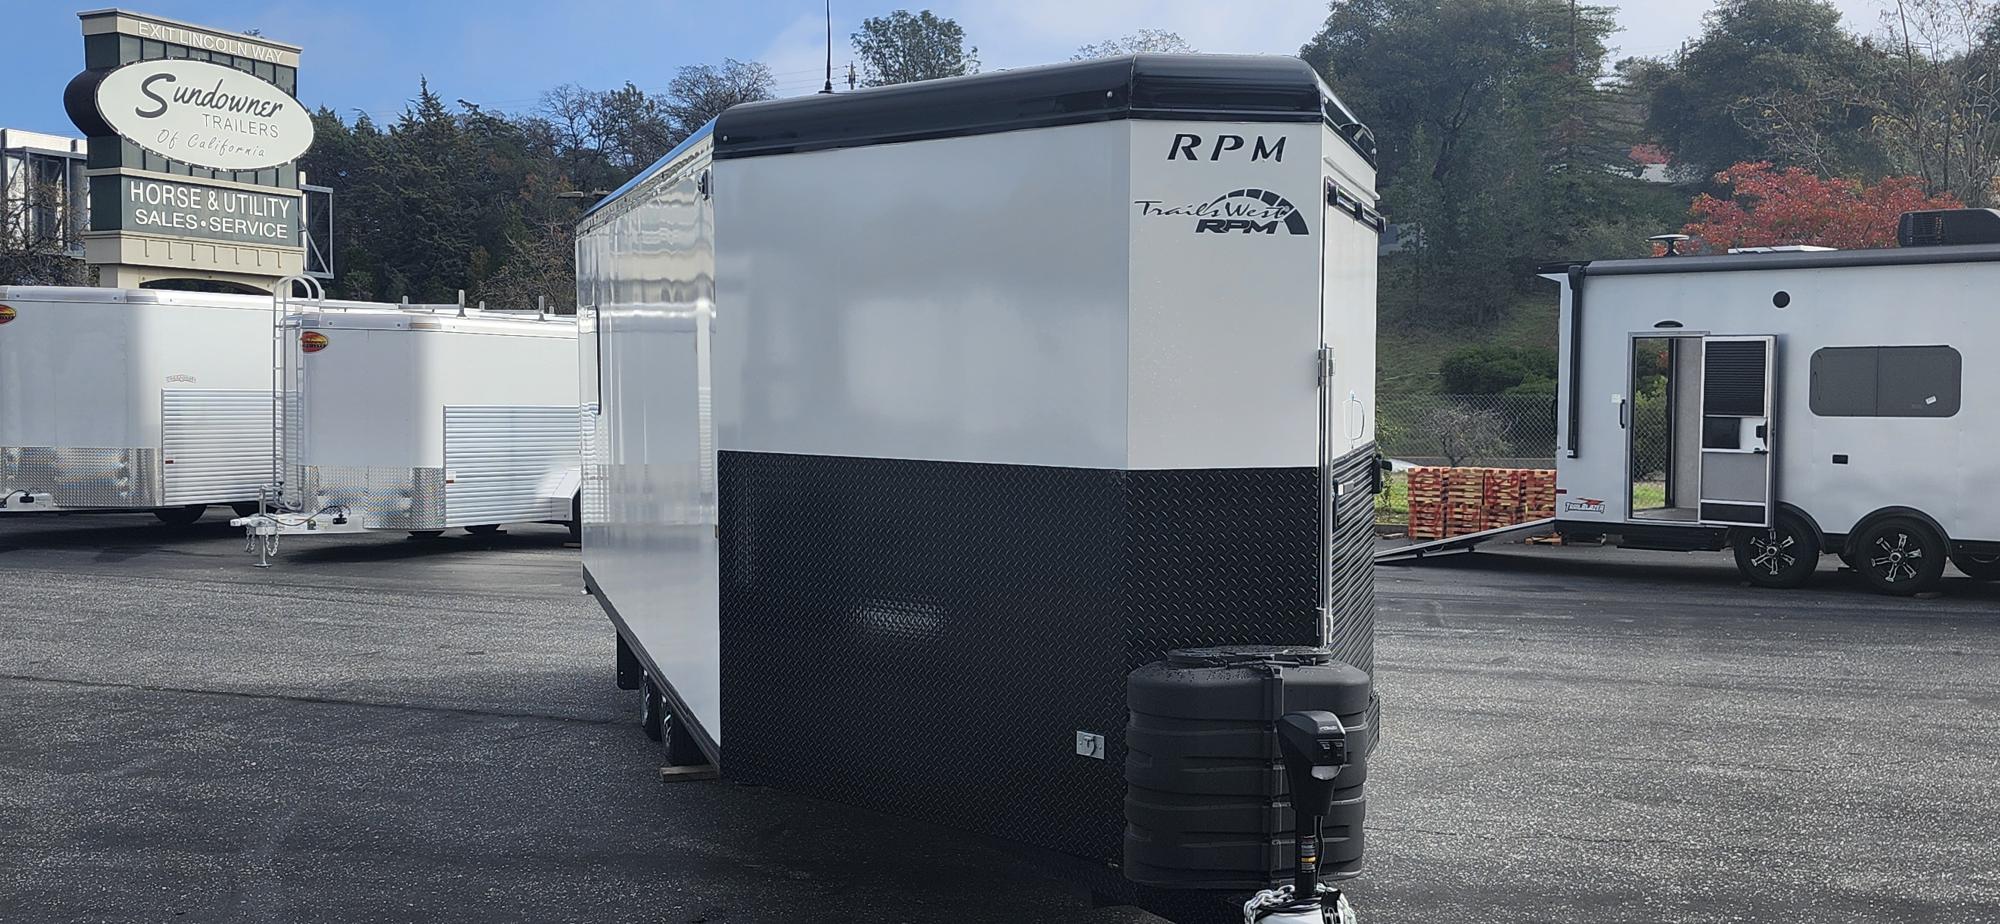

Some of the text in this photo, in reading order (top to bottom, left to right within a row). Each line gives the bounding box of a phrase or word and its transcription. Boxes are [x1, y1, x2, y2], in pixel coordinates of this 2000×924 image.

[138, 21, 284, 63] EXIT LINCOLN WAY
[135, 73, 283, 119] Sundowner
[202, 113, 279, 138] TRAILERS
[156, 129, 265, 157] Of California
[1167, 133, 1287, 163] RPM
[130, 181, 290, 218] HORSE & UTILITY
[1225, 202, 1285, 219] West
[135, 209, 288, 239] SALES SERVICE
[1195, 219, 1279, 235] RPM
